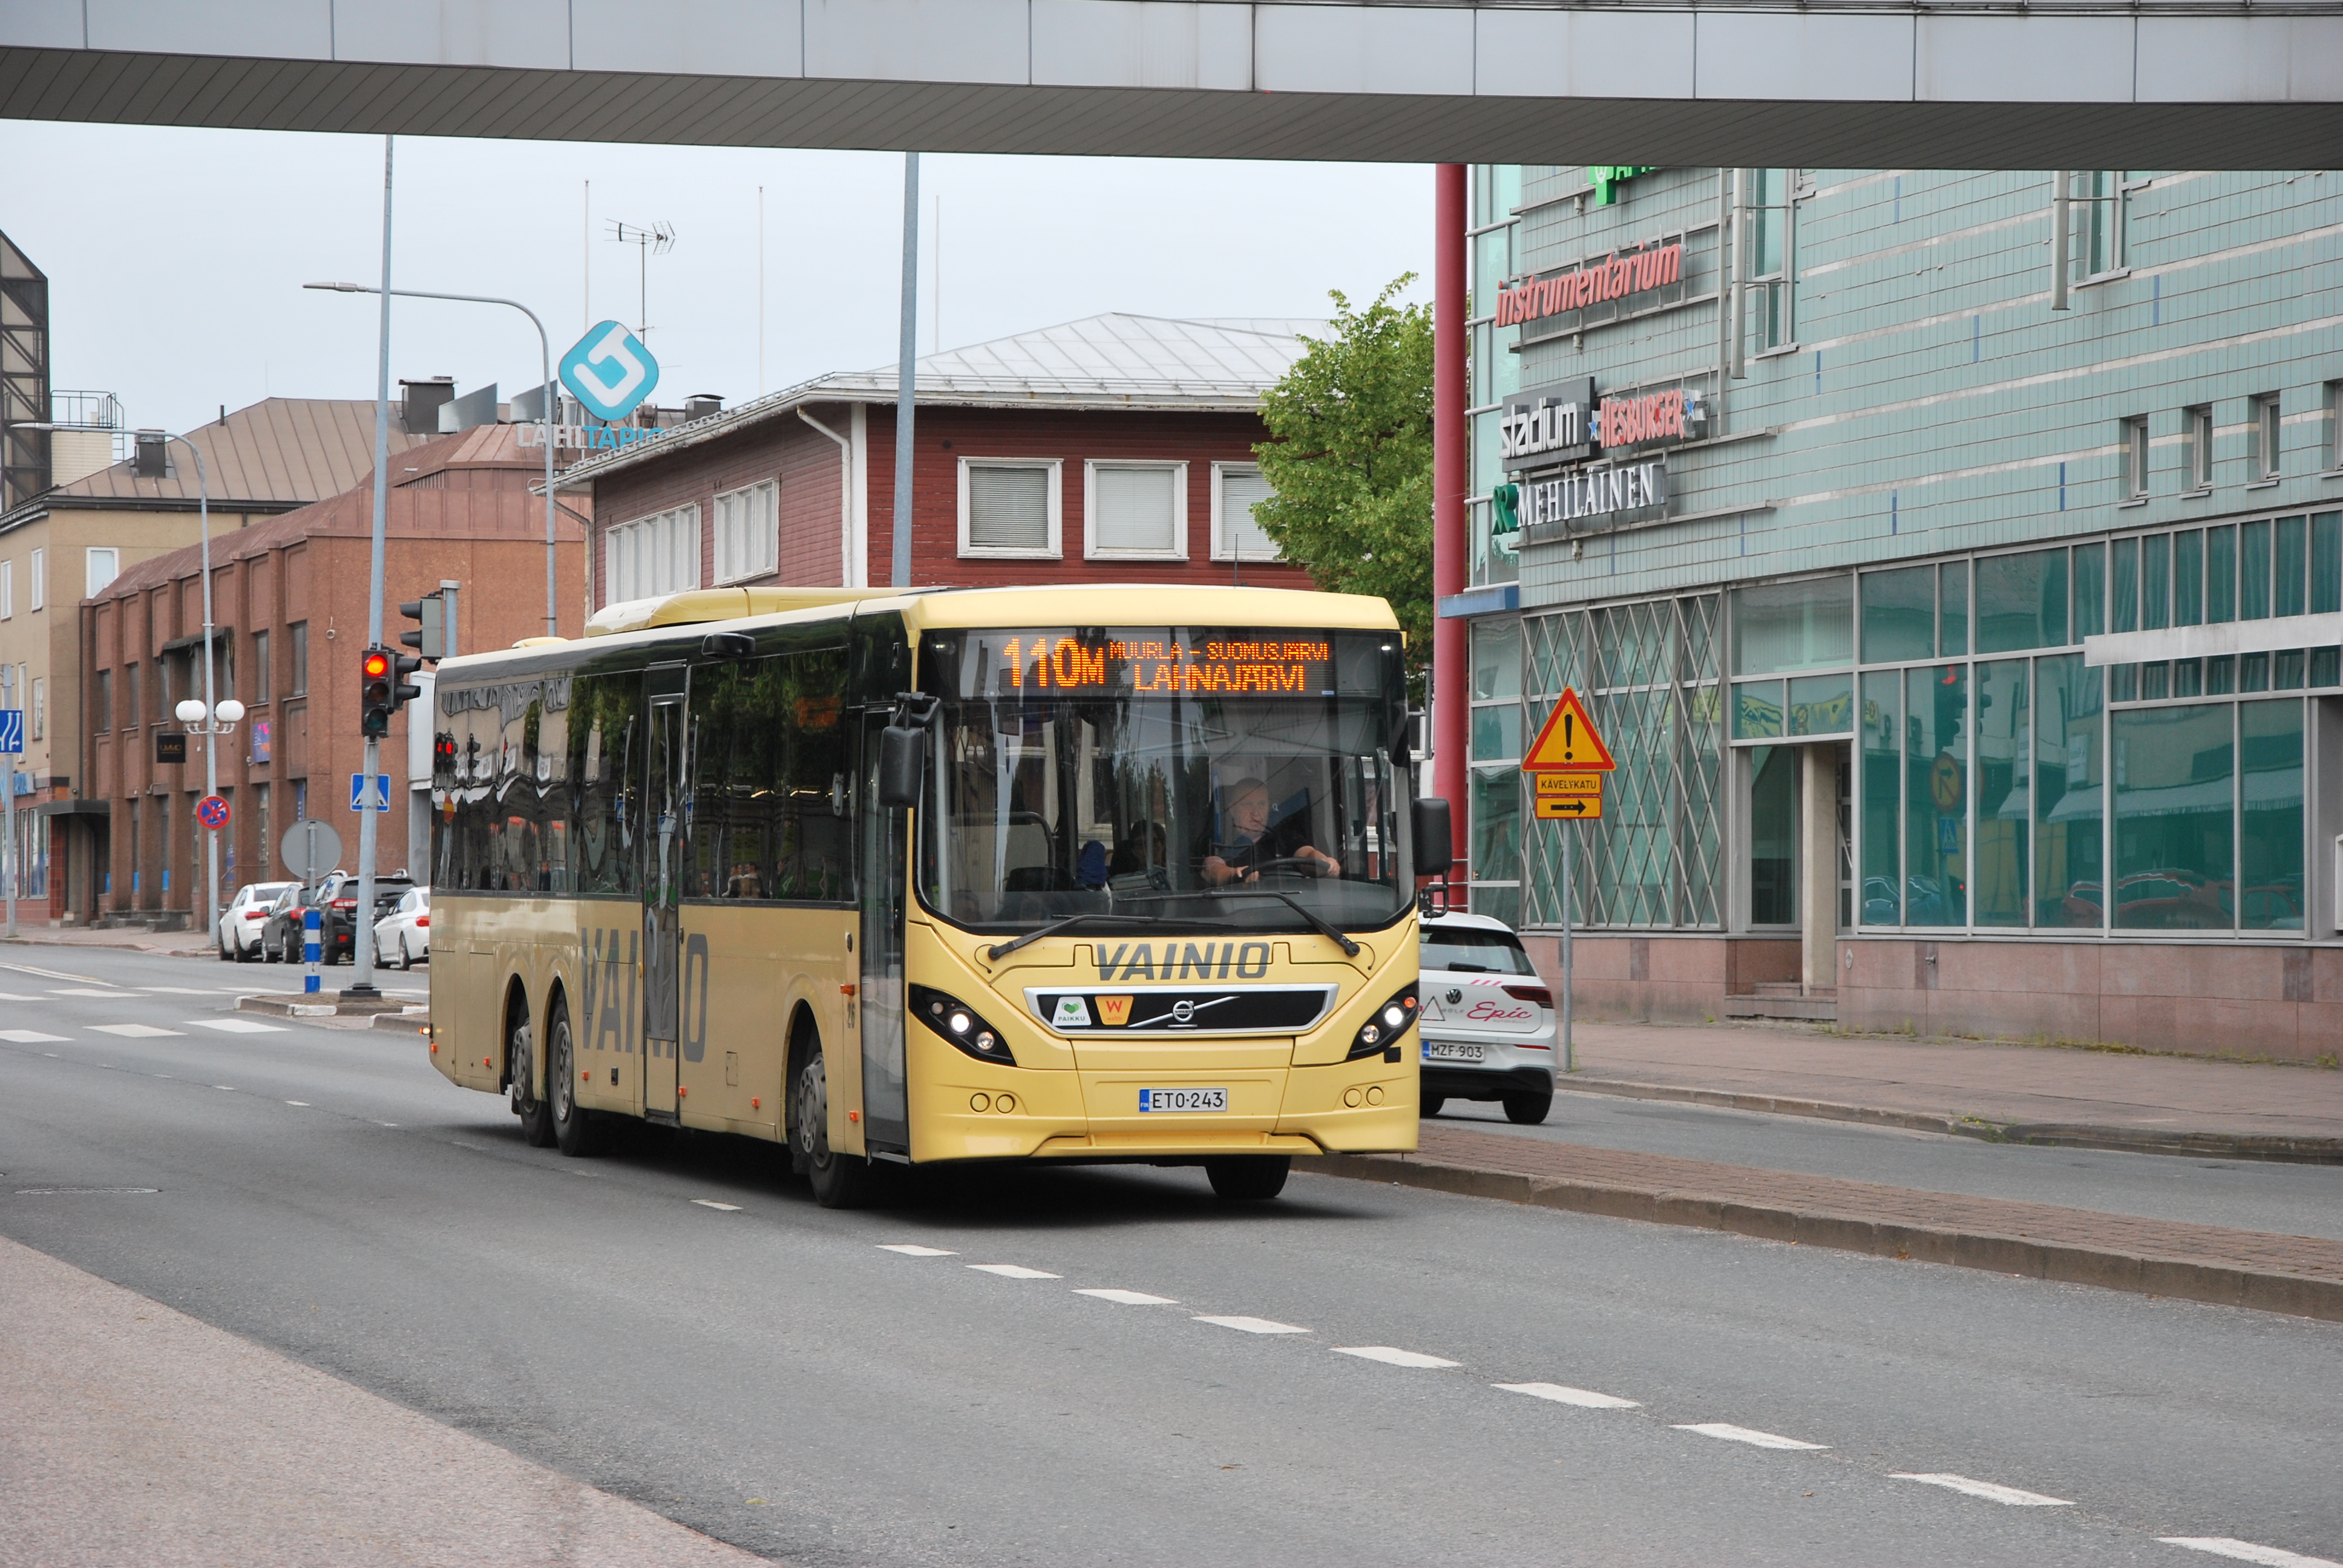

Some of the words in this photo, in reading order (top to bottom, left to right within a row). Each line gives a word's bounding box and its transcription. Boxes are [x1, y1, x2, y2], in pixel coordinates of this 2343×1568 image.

[1495, 240, 1680, 328] instrumentarium
[1499, 397, 1578, 459] stadium
[1600, 388, 1685, 449] HESBURGER
[1517, 463, 1657, 528] MEHILÄINEN
[1003, 638, 1104, 687] 110M
[1110, 641, 1183, 660] MUURLA
[1207, 642, 1328, 661] SUOMUSJÄRVI
[1135, 664, 1304, 691] LAHNAJÄRVI
[1541, 779, 1597, 789] KÄVELYKATU
[1096, 942, 1270, 981] VAINIO
[1466, 1001, 1532, 1022] Epic
[1430, 1044, 1483, 1058] MZF-903
[1152, 1091, 1224, 1109] ETO-243
